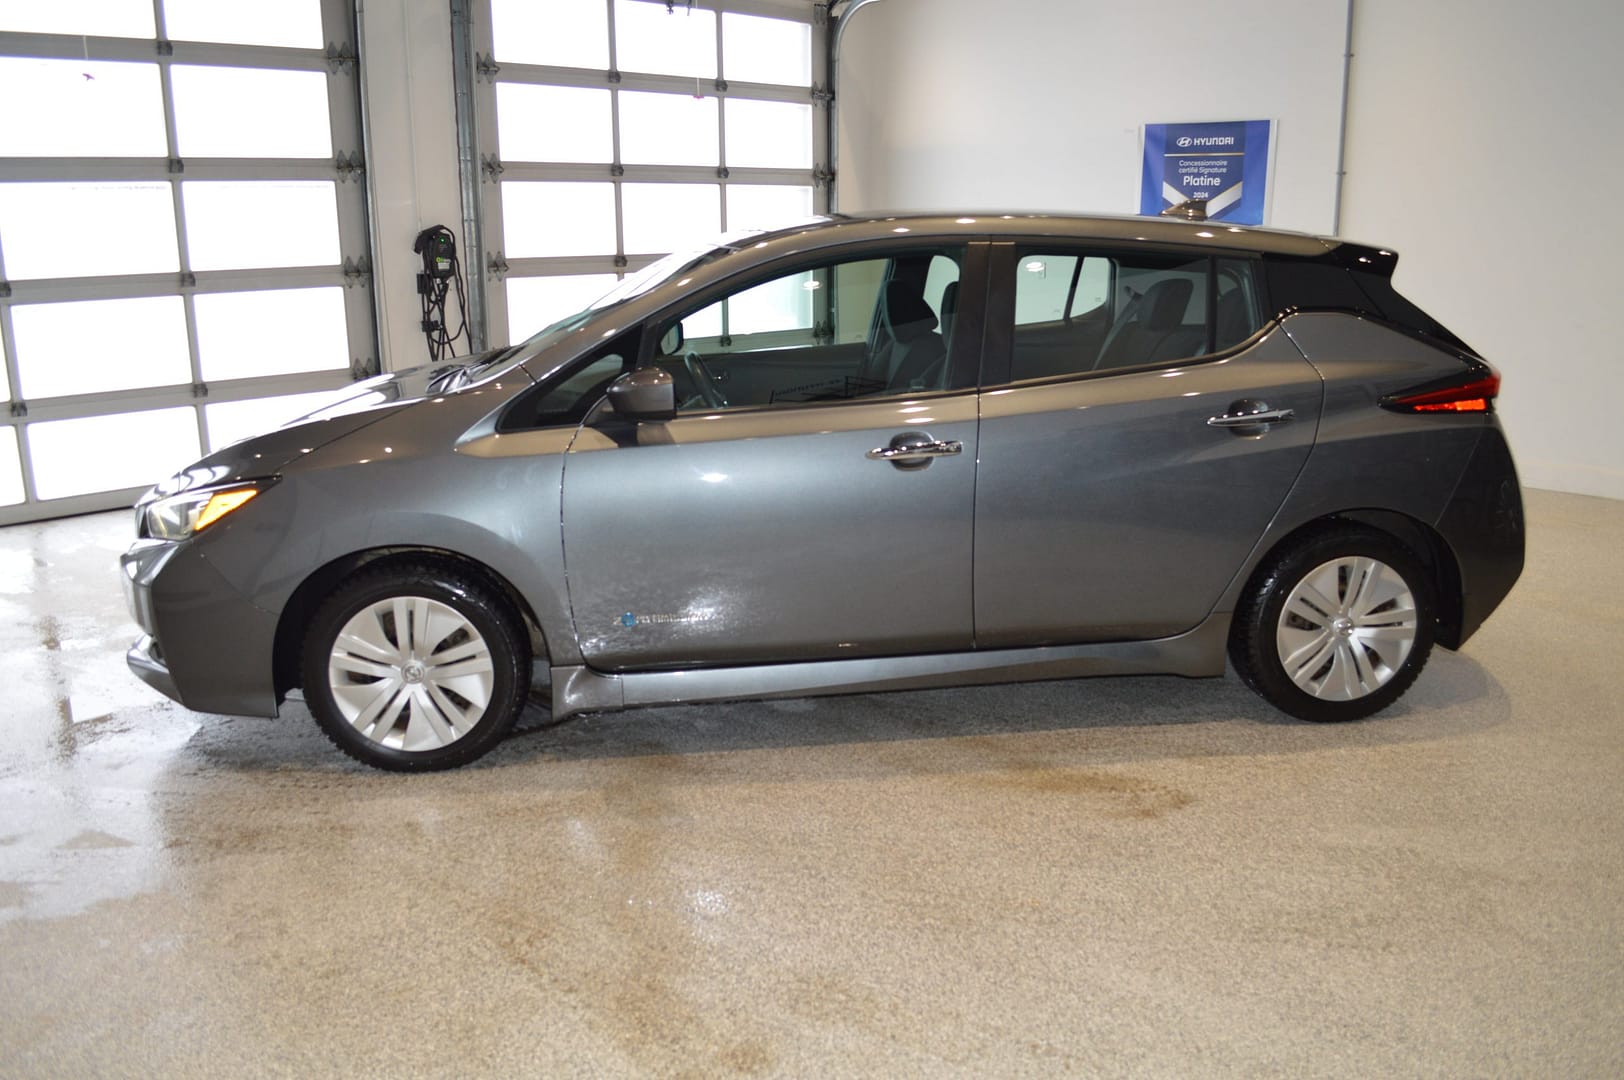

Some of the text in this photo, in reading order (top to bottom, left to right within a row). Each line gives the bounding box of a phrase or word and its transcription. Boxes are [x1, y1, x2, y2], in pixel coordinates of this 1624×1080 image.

[1194, 137, 1234, 146] HYUNDAI
[1199, 166, 1227, 174] Signature
[1183, 175, 1221, 186] Platine
